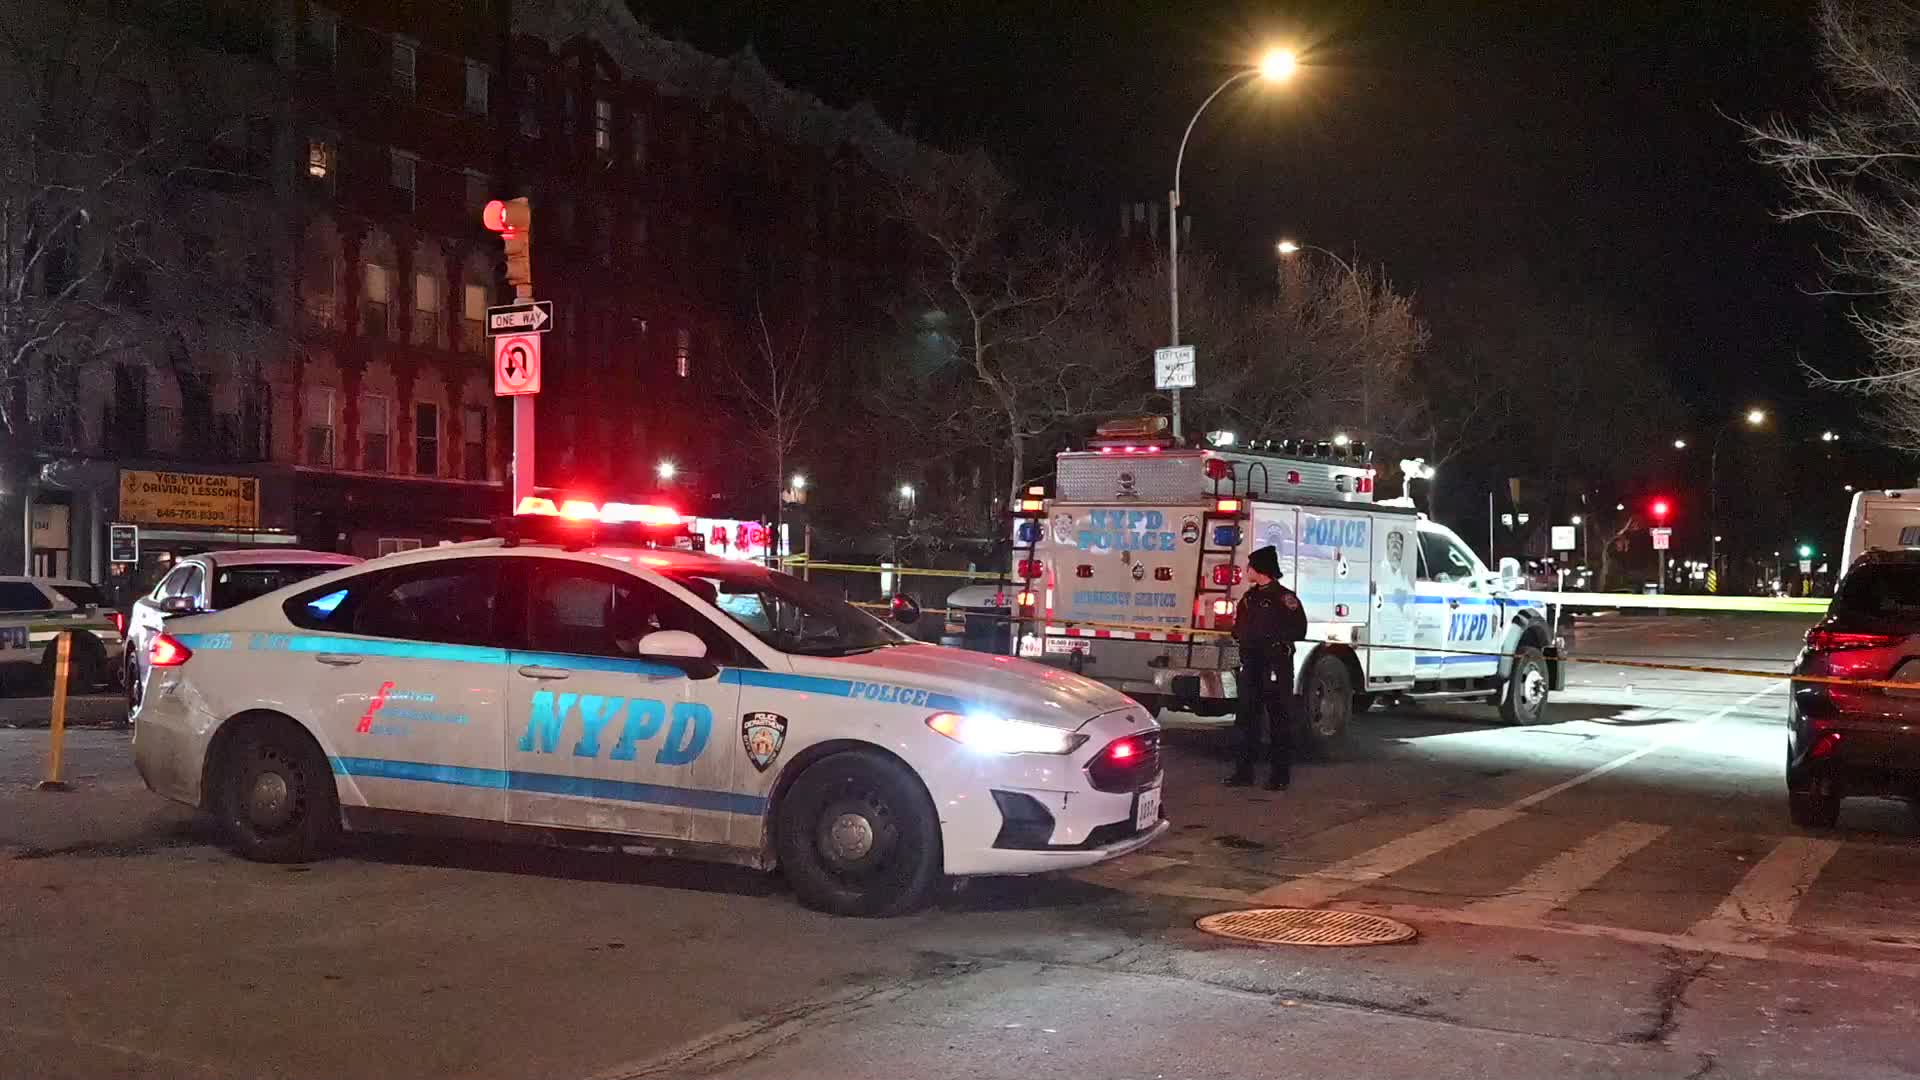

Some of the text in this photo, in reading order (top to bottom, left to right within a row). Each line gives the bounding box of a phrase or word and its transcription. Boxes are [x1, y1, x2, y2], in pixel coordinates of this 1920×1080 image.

[496, 312, 542, 326] ONE WAY
[142, 483, 240, 497] DRIVING LESSONS
[155, 473, 228, 488] YES YOU CAN
[1088, 510, 1163, 529] NYPD
[1078, 530, 1176, 551] POLICE
[1304, 517, 1366, 548] POLICE
[1448, 613, 1488, 641] NYPD
[849, 681, 928, 707] POLICE
[744, 719, 784, 732] DEPARTMENT
[754, 712, 778, 722] POLICE
[518, 691, 712, 766] NYPD
